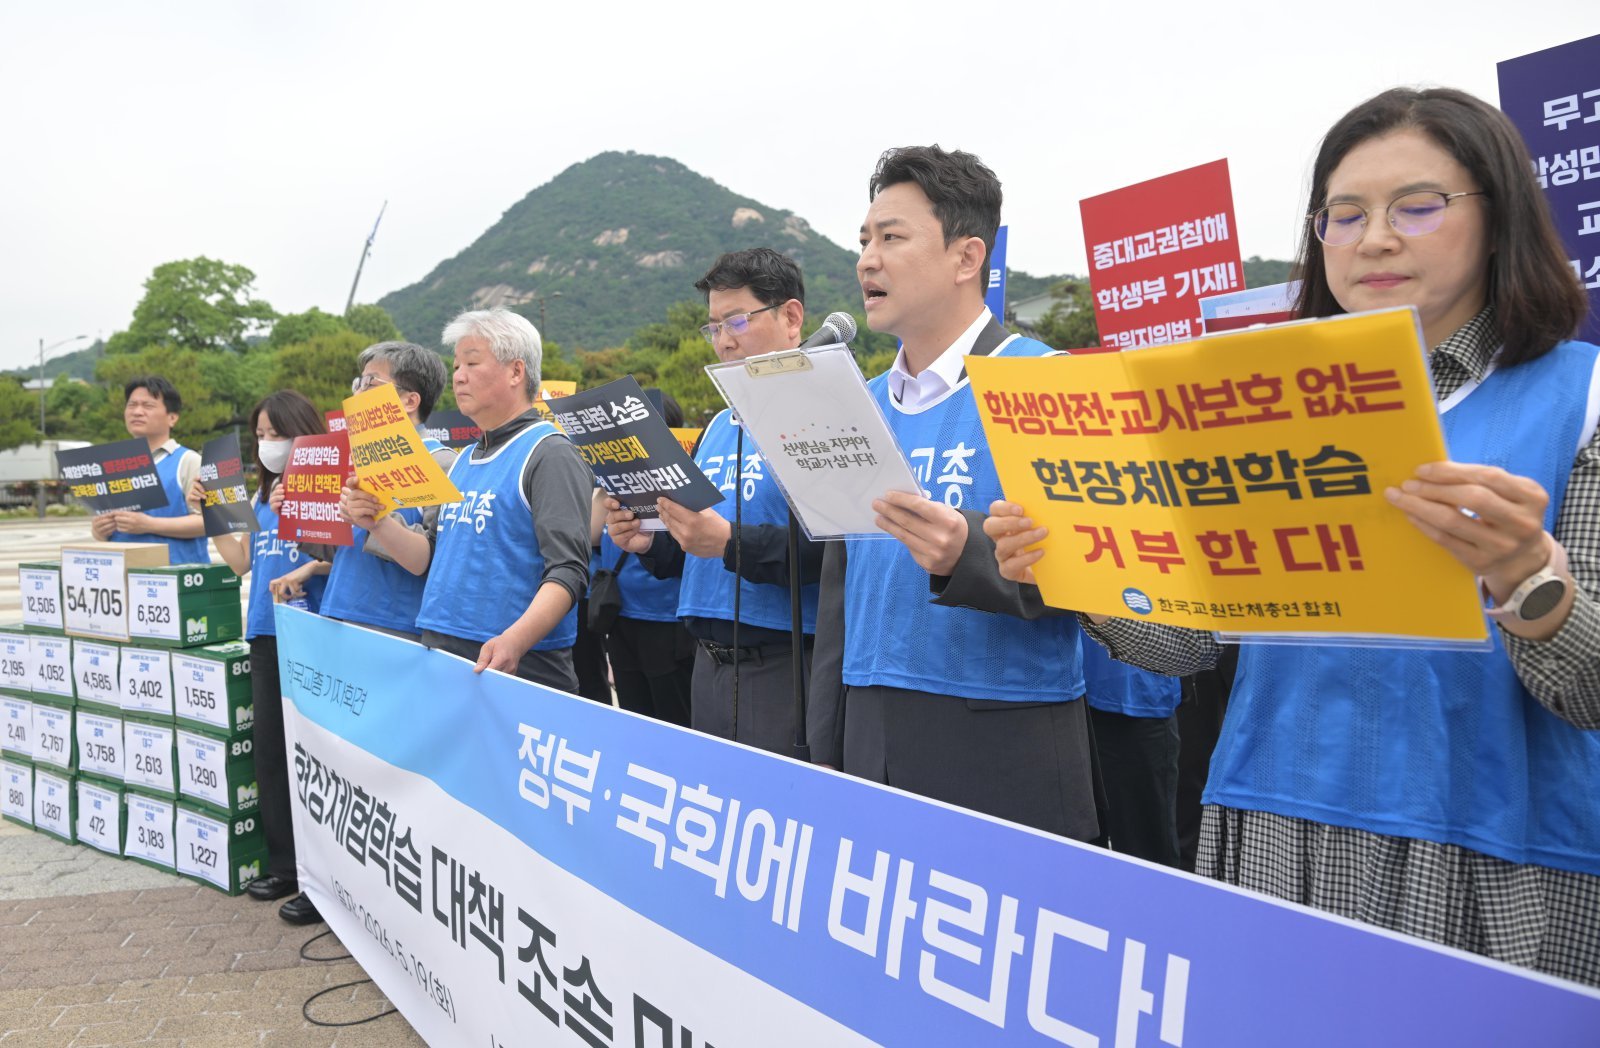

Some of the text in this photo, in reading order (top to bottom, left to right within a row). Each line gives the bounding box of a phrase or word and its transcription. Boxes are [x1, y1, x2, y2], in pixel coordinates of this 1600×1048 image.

[1093, 213, 1229, 271] 중대교권침해
[1097, 261, 1238, 313] 학생부 기재!
[982, 362, 1406, 437] 학생안전·교사보호 없는
[576, 404, 616, 432] 관련
[610, 395, 650, 426] 소송
[292, 446, 340, 466] 현장체험학습
[783, 436, 871, 459] 선생님을 지켜야
[795, 452, 879, 472] 학교가 삽니다!
[107, 473, 158, 494] 전담하라
[287, 474, 341, 495] 민·형사 면책권
[607, 463, 691, 496] 도입하라!!
[1030, 444, 1373, 508] 현장체험학습
[280, 500, 300, 520] 즉각
[183, 573, 204, 587] 80
[27, 596, 55, 615] 12,505
[66, 585, 122, 618] 54,705
[1158, 596, 1342, 620] 한국교원단체총연합회
[137, 604, 170, 625] 6,523
[187, 633, 208, 643] COPY
[2, 659, 25, 677] 2,195
[38, 663, 65, 683] 4,052
[232, 660, 252, 676] 80
[83, 671, 112, 691] 4,585
[129, 678, 163, 699] 3,402
[286, 659, 368, 717] 한국교총 기자회견
[185, 686, 216, 710] 1,555
[41, 733, 64, 753] 2,767
[86, 742, 116, 763] 3,758
[232, 739, 253, 756] 80
[135, 754, 163, 776] 2,613
[189, 763, 217, 788] 1,290
[9, 789, 24, 807] 880
[42, 800, 61, 822] 1,287
[89, 816, 105, 836] 472
[234, 818, 255, 836] 80
[139, 826, 164, 849] 3,183
[190, 842, 217, 868] 1,227
[294, 741, 422, 914] 현장체험학습
[431, 845, 505, 985] 대책
